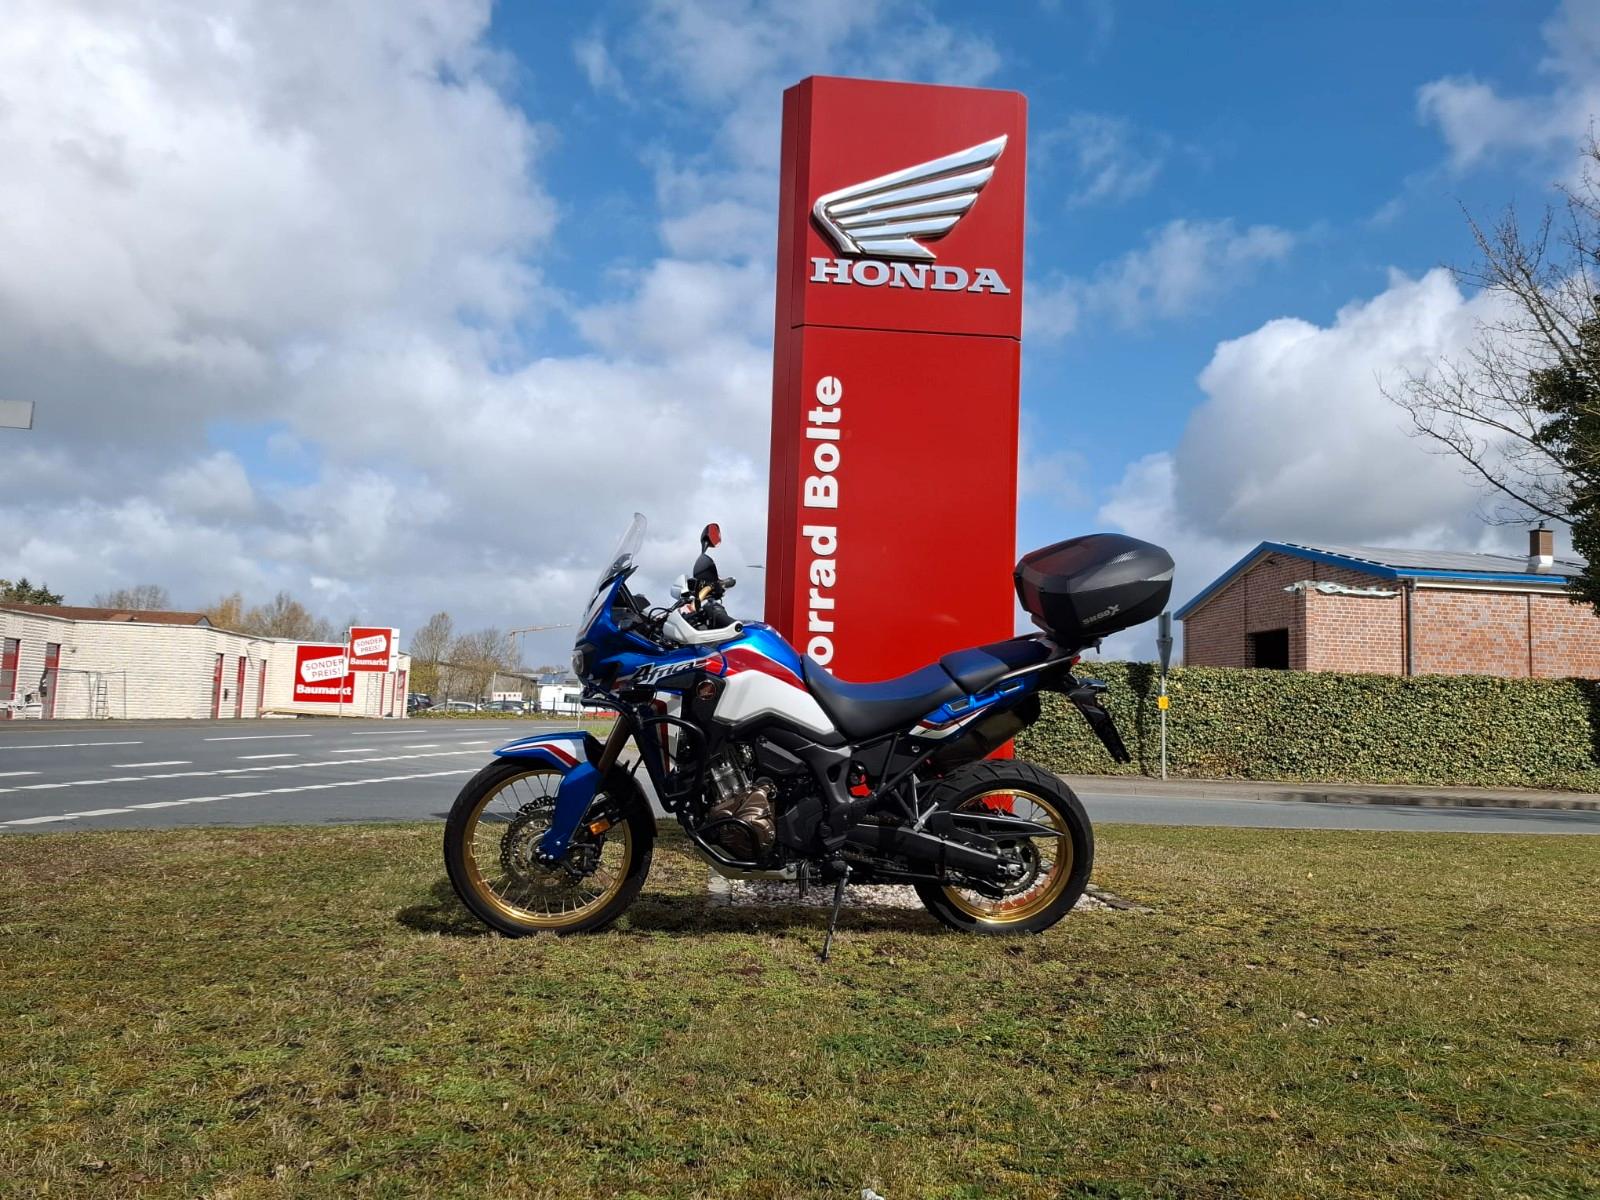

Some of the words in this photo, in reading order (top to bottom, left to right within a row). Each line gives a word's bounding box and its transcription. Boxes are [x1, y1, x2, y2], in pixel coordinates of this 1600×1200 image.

[811, 257, 1011, 294] HONDA
[804, 376, 842, 508] Bolte
[803, 525, 837, 675] orrad
[305, 658, 344, 671] SONDER
[350, 657, 388, 666] Baumarkt
